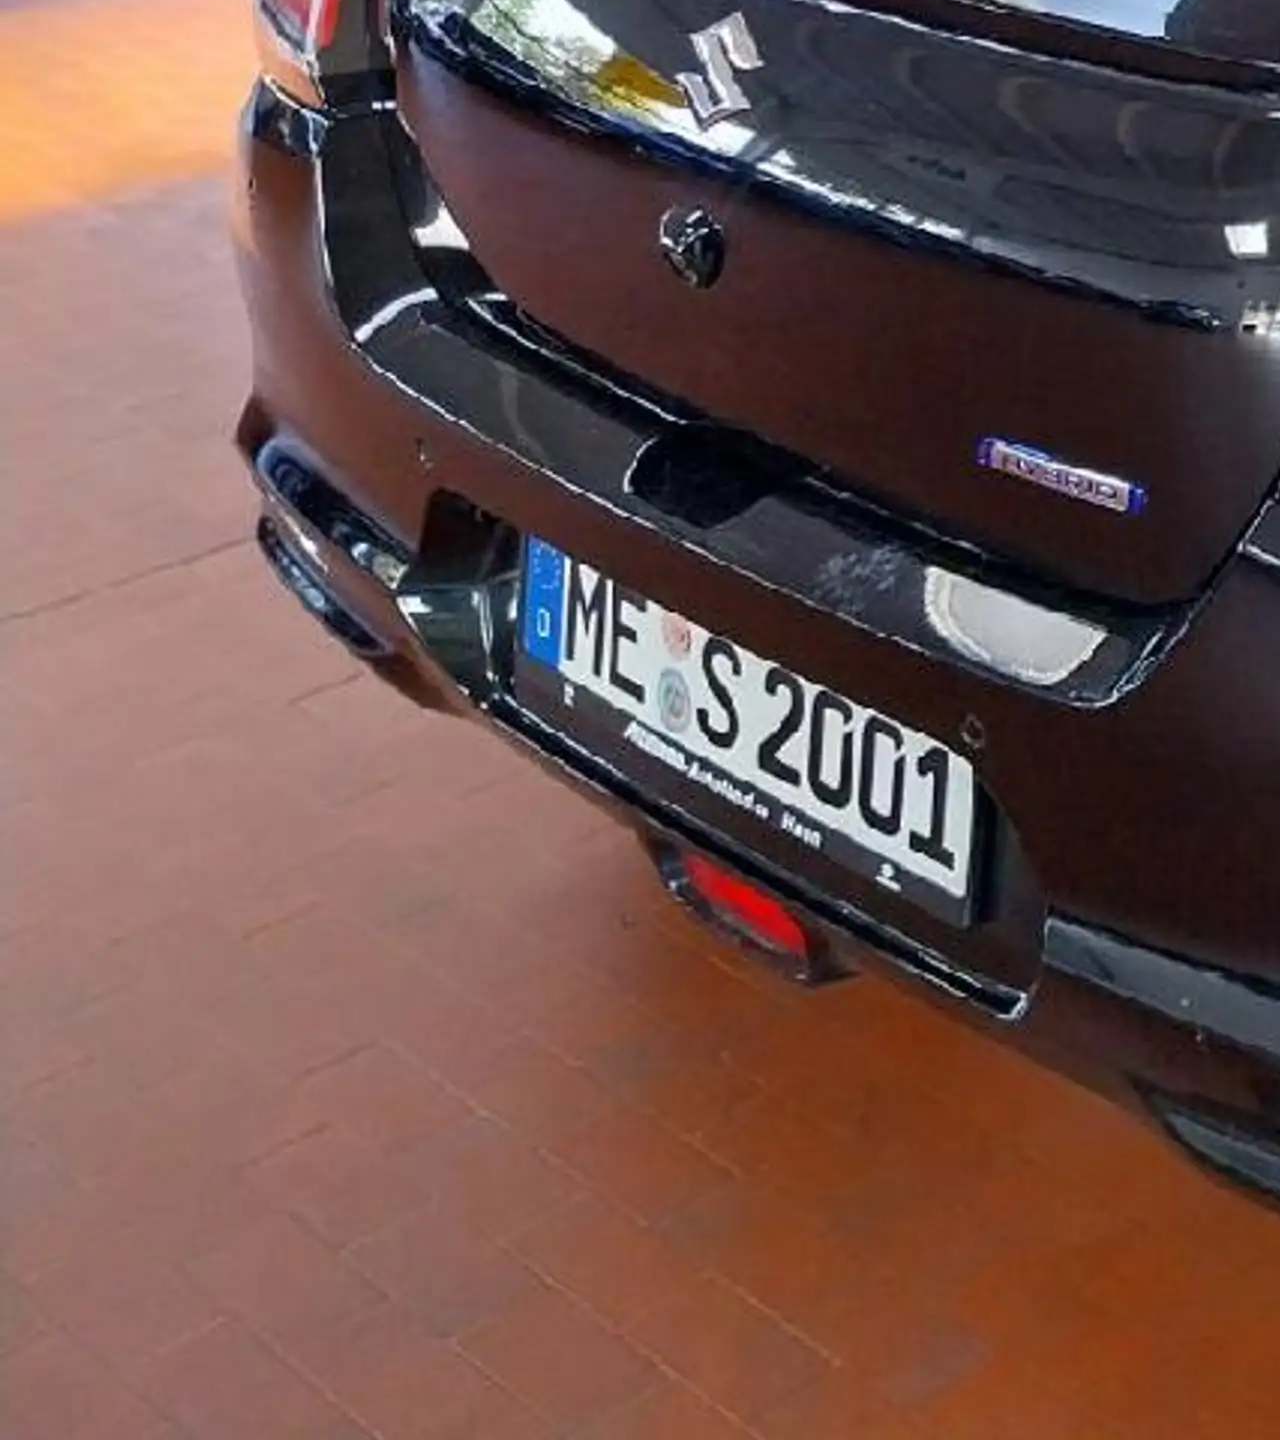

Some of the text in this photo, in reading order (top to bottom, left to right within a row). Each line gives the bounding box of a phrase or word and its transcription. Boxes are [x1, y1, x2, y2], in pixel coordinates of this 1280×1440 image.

[565, 563, 645, 704] ME
[697, 636, 742, 749] S
[758, 666, 955, 872] 2001
